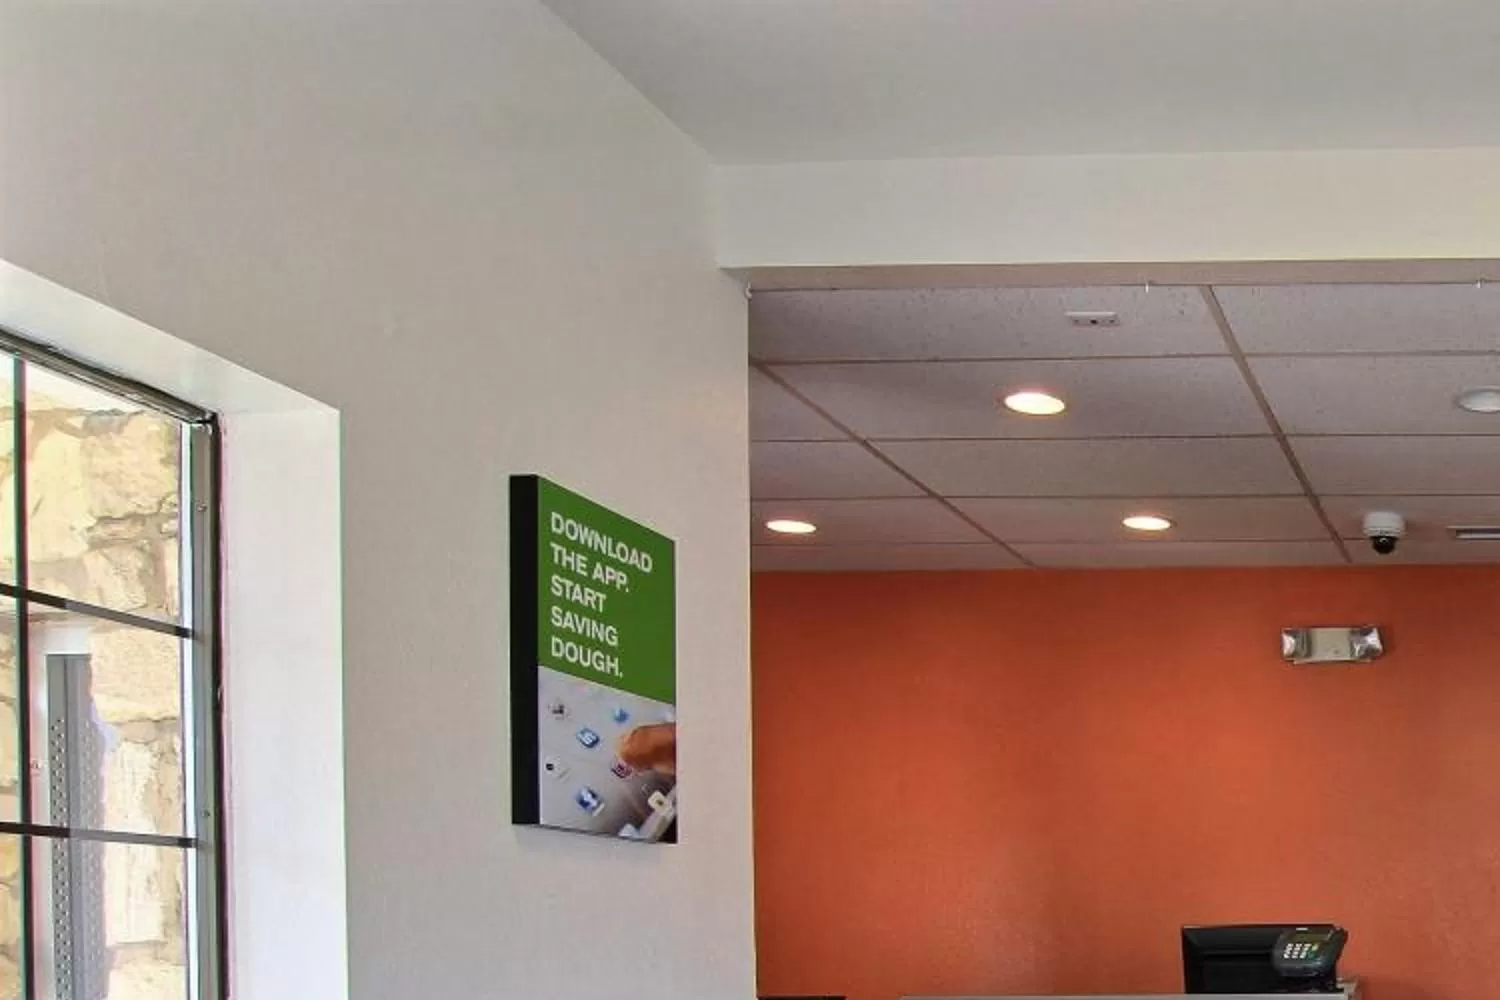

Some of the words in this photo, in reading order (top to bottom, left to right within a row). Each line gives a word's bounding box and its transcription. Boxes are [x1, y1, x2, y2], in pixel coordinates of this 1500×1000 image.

[550, 511, 653, 573] DOWNLOAD
[550, 542, 588, 576] THE
[593, 559, 630, 592] APP.
[550, 574, 606, 614] START
[550, 606, 619, 647] SAVING
[550, 637, 624, 678] DOUGH.
